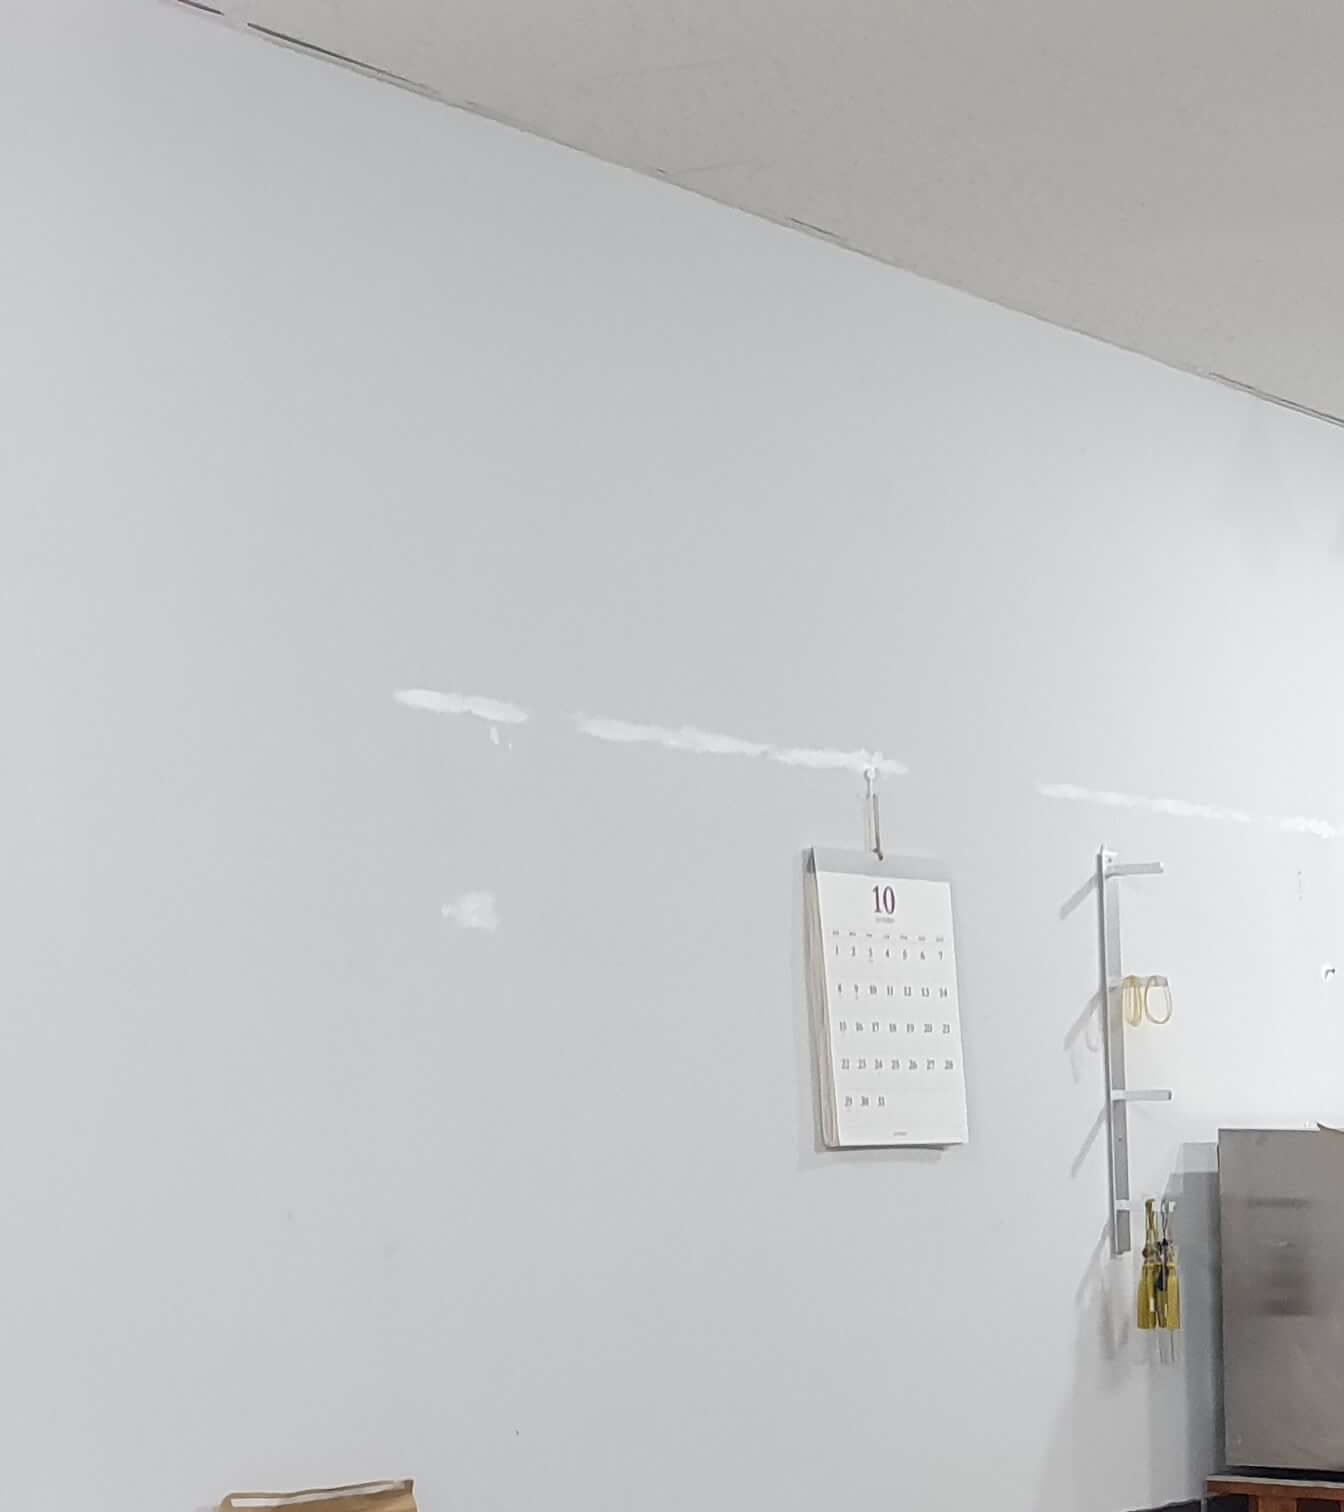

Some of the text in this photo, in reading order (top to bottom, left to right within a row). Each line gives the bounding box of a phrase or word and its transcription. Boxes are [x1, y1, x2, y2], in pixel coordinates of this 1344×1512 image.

[871, 885, 897, 915] 10
[868, 985, 878, 995] 10
[886, 985, 894, 996] 11
[903, 986, 912, 997] 12
[920, 987, 931, 997] 13
[938, 987, 949, 998] 14
[838, 1021, 951, 1034] 15 16 17 18 19 20 21
[840, 1058, 955, 1070] 22 23 24 25 26 27 28
[843, 1096, 886, 1107] 29 30 31
